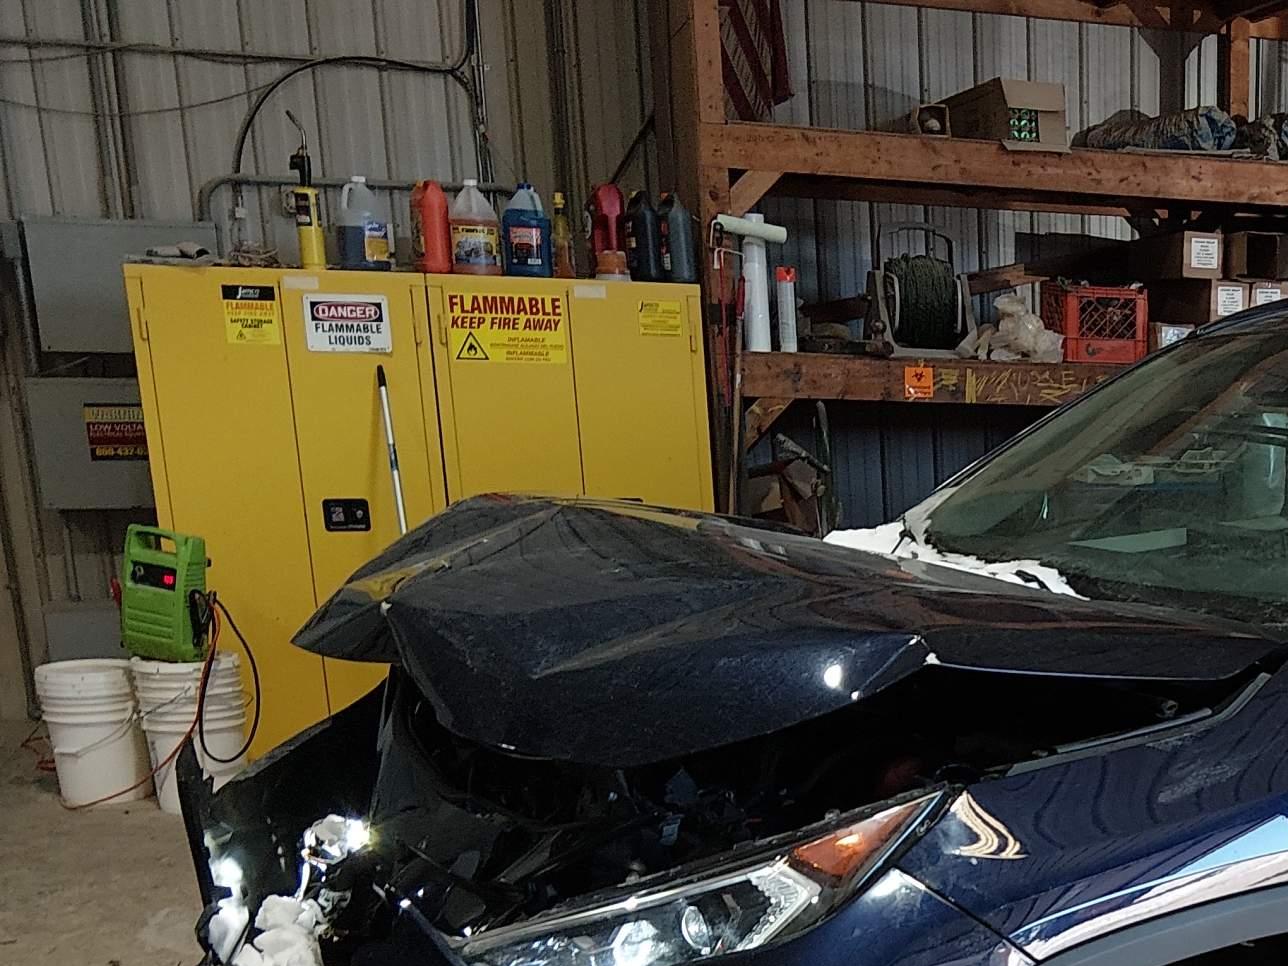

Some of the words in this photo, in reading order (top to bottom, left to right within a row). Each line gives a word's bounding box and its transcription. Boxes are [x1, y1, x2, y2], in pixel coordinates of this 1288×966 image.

[448, 294, 562, 316] FLAMMABLE
[318, 305, 377, 318] DANGER
[315, 323, 383, 334] FLAMMABLE
[451, 316, 486, 329] KEEP
[490, 317, 520, 330] FIRE
[523, 318, 561, 331] AWAY
[328, 335, 372, 346] LIQUIDS
[89, 423, 112, 431] LOW
